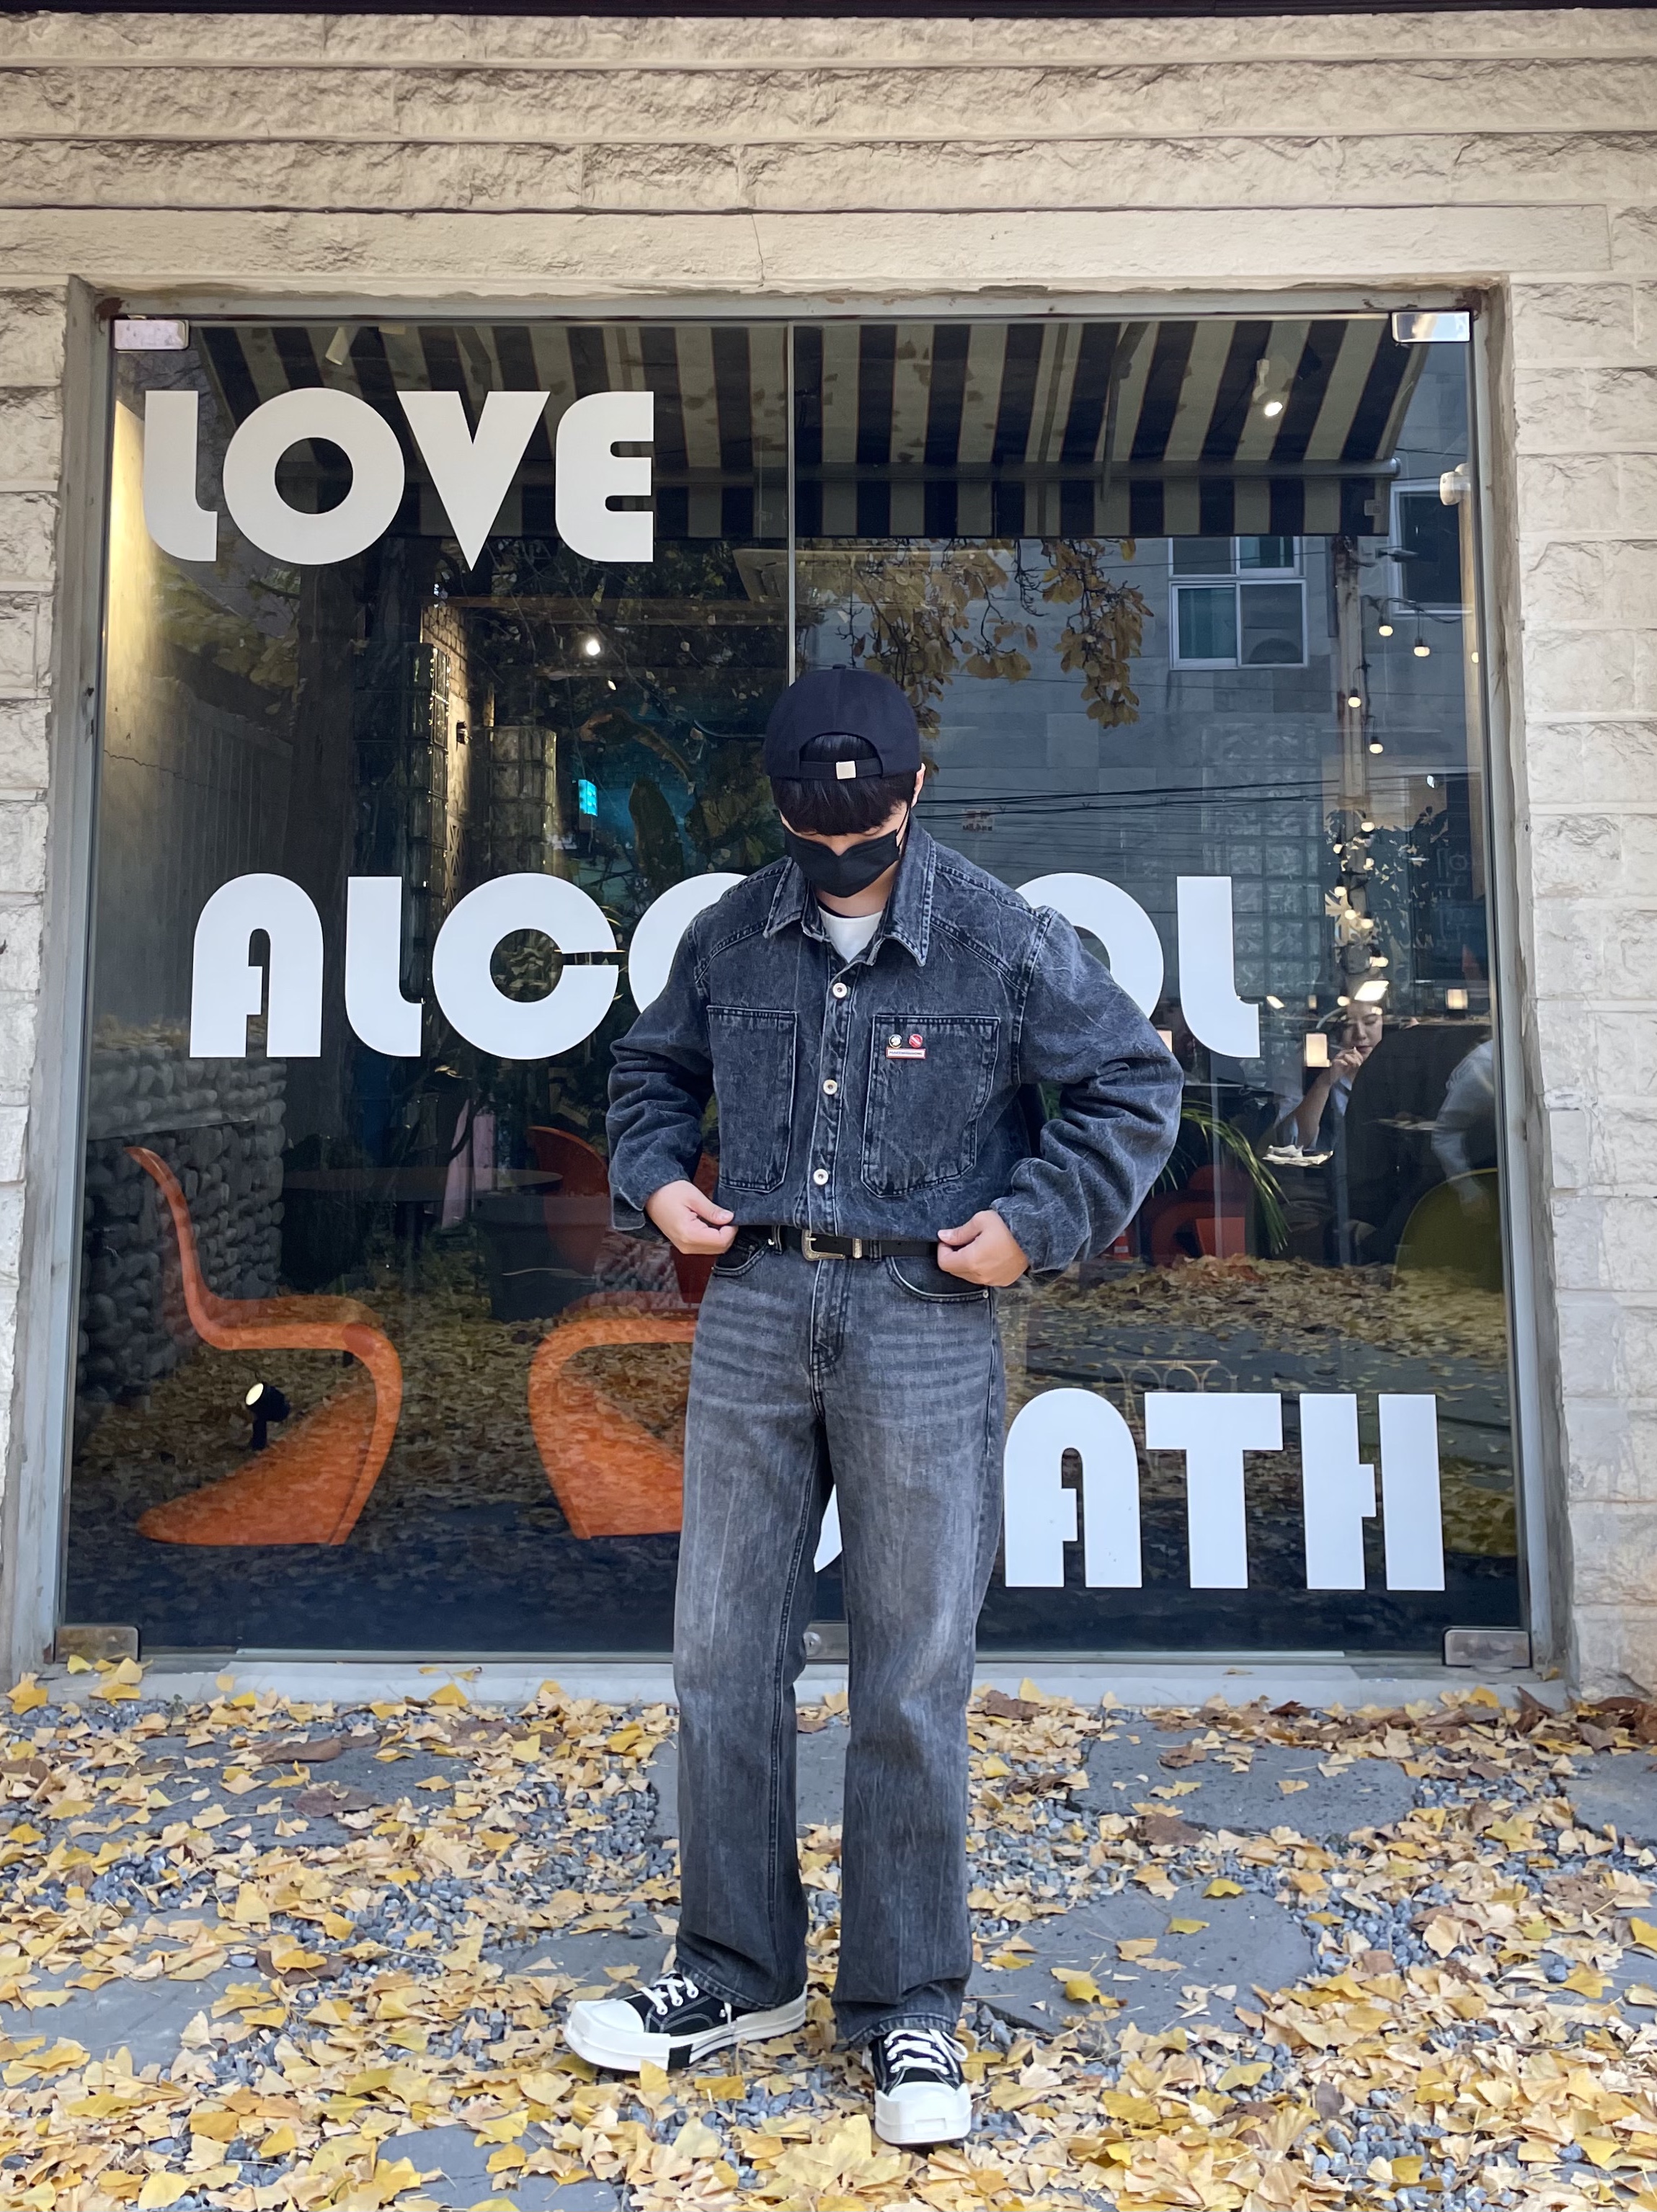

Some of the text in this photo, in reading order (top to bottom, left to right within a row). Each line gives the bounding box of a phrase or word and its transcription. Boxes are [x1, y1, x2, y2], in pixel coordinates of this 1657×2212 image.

[144, 387, 654, 572] LOVE
[189, 872, 1261, 1060] ALCL
[813, 1387, 1446, 1591] ATH
